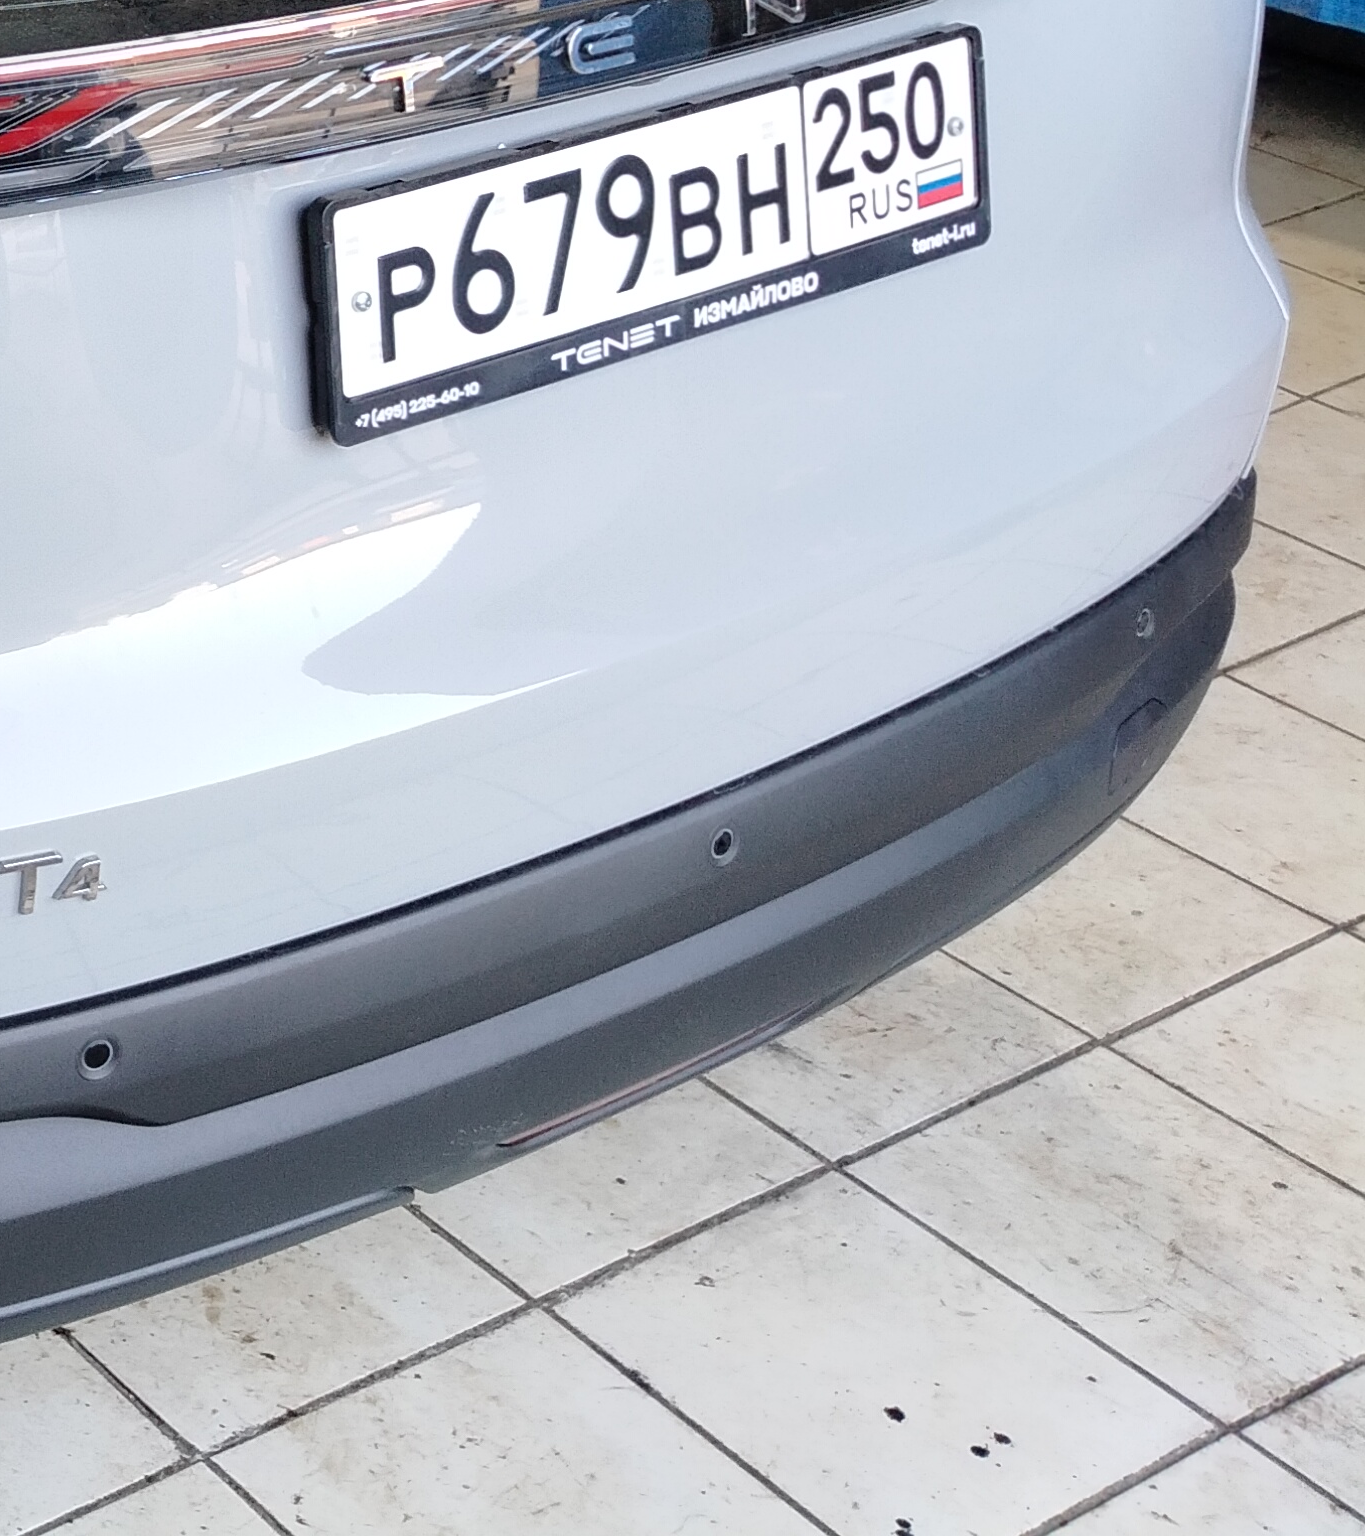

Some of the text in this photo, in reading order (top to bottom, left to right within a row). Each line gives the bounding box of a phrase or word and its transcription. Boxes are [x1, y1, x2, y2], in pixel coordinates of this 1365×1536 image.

[811, 61, 946, 193] 250
[377, 142, 792, 363] Р679ВН
[849, 178, 913, 229] RUS
[551, 271, 819, 372] TENET ИЗМАЙЛОВО
[355, 381, 480, 428] +7 (495) 225-60-10
